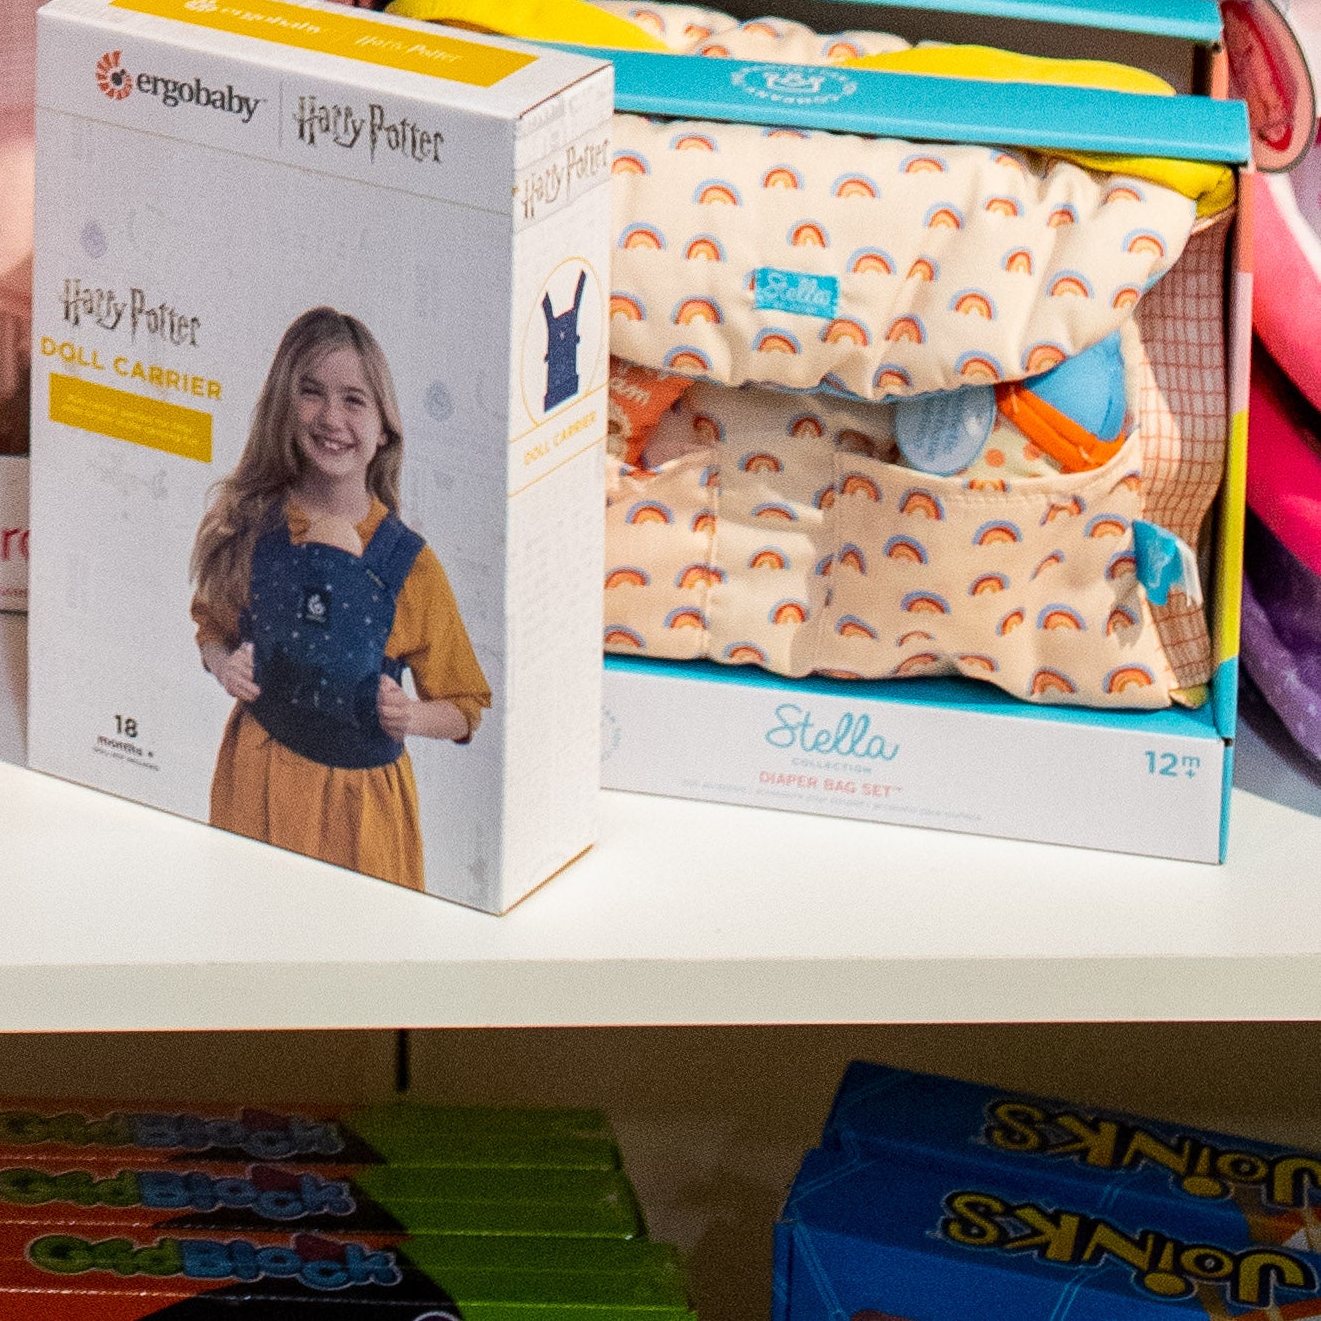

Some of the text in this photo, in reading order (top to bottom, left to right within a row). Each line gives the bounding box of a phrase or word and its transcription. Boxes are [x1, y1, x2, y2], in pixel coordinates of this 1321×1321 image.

[137, 70, 444, 163] ergobaby Harry Potter
[521, 137, 610, 219] Harry Potter
[62, 278, 202, 346] Harry Potter
[41, 336, 222, 401] DOLL CARRIER
[114, 713, 138, 738] 18
[765, 703, 901, 761] Stella
[759, 771, 818, 790] DIAPER
[823, 777, 857, 794] BAG
